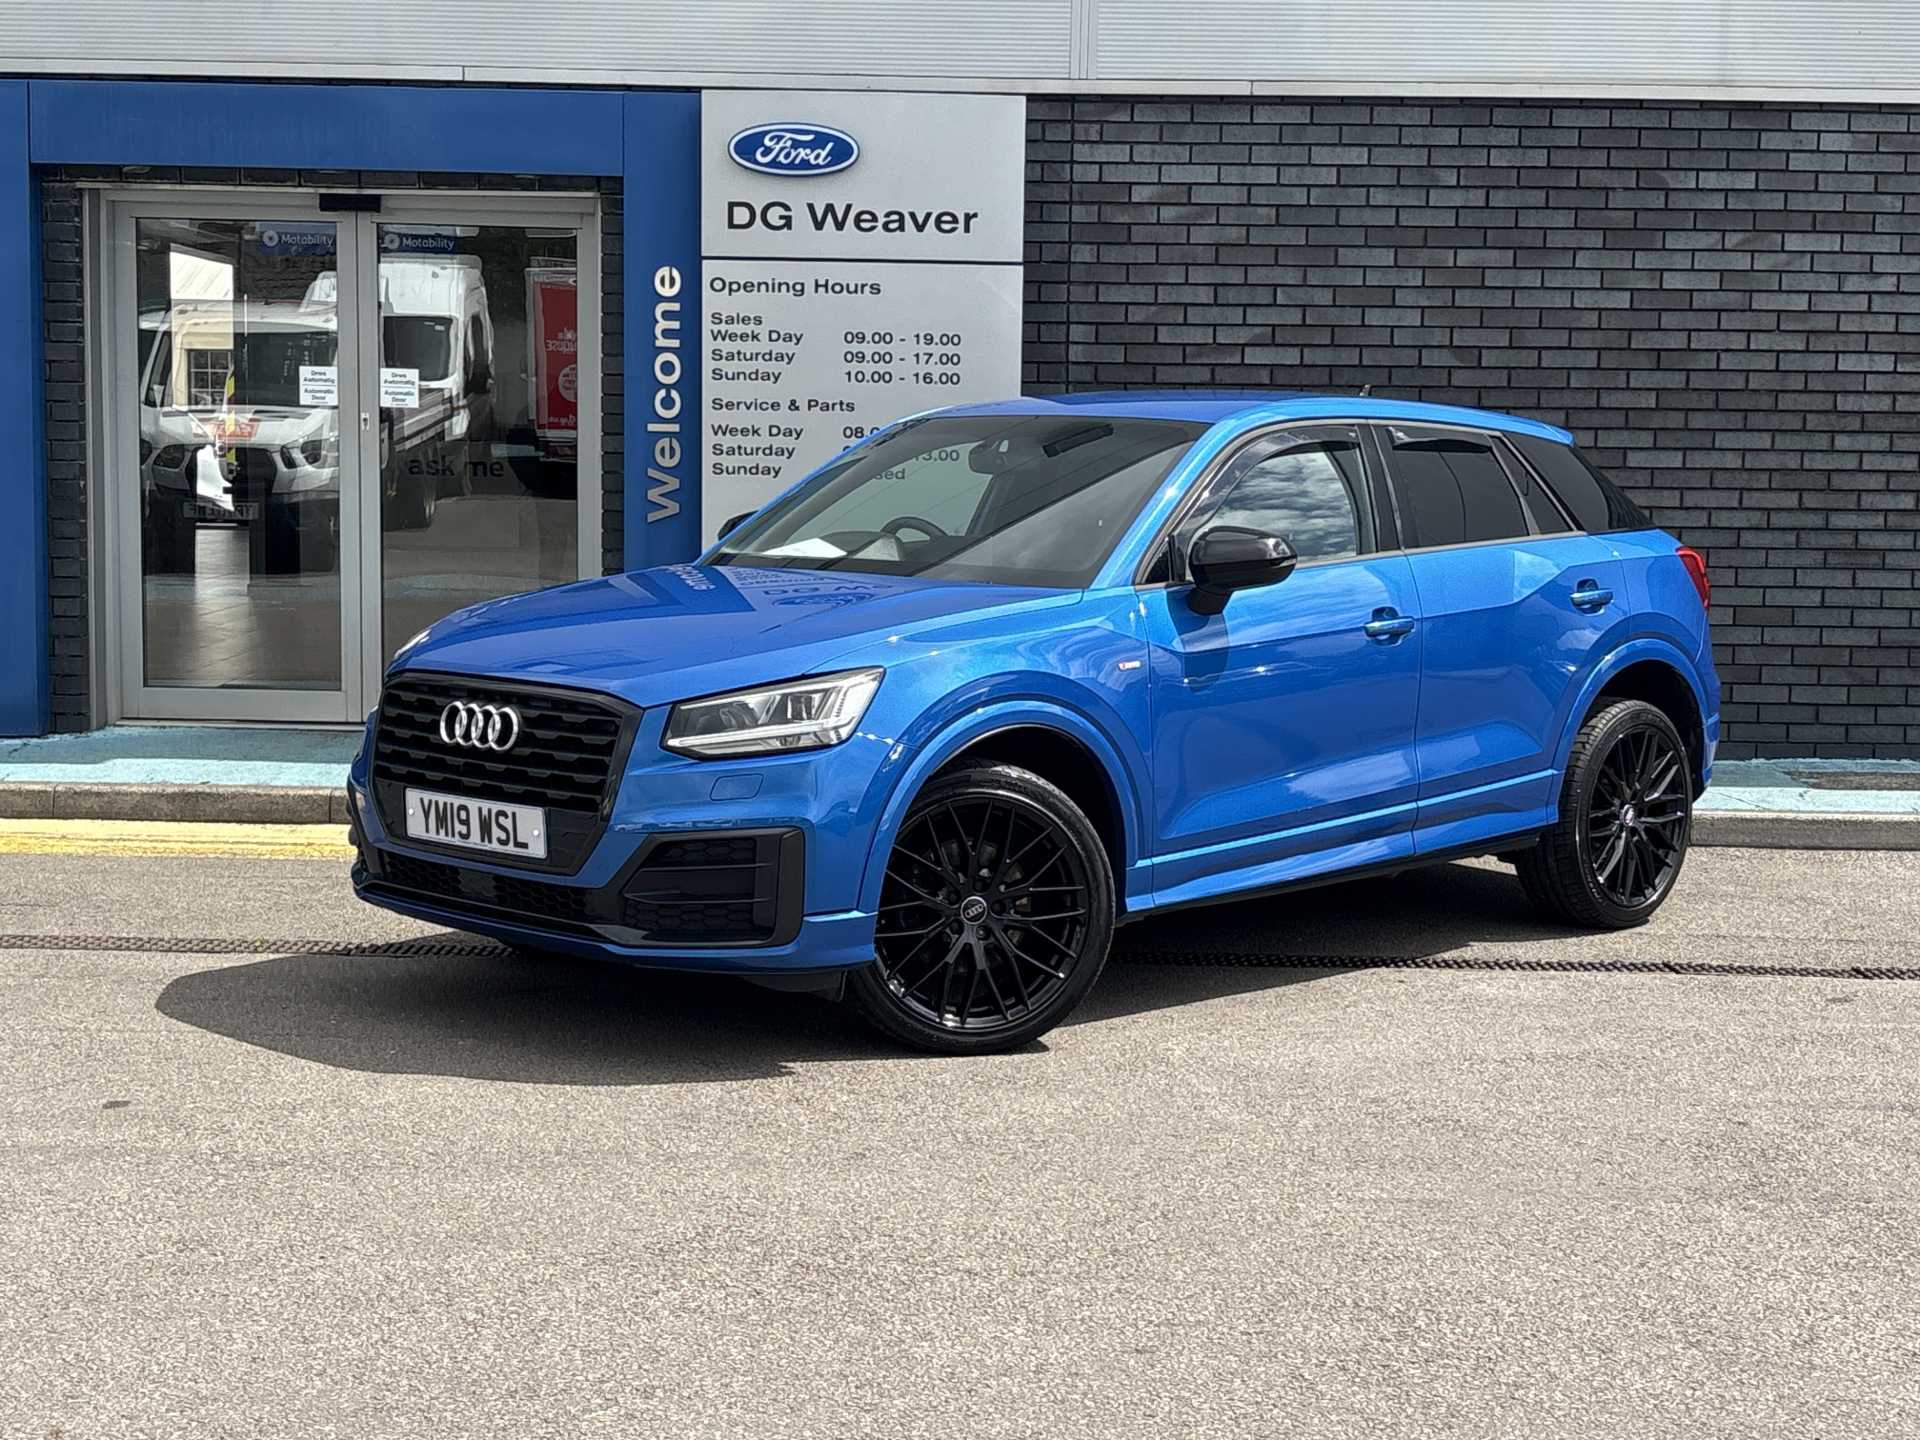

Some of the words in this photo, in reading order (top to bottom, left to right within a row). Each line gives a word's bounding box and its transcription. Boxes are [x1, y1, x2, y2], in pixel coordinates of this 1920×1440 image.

[755, 130, 834, 165] Ford
[727, 200, 793, 232] DG
[806, 202, 979, 234] Weaver
[281, 233, 334, 248] Motability
[402, 237, 455, 252] Motability
[709, 276, 806, 297] Opening
[814, 278, 882, 296] Hours
[710, 311, 763, 326] Sales
[710, 328, 761, 343] Week
[768, 329, 804, 346] Day
[843, 331, 894, 345] 09.00
[913, 332, 962, 347] 19.00
[711, 348, 796, 366] Saturday
[843, 350, 894, 365] 09.00
[913, 352, 961, 367] 17.00
[711, 367, 782, 385] Sunday
[845, 370, 893, 384] 10.00
[912, 371, 961, 386] 16.00
[646, 265, 682, 524] Welcome
[711, 397, 781, 412] Service
[787, 398, 801, 412] &
[807, 398, 856, 413] Parts
[710, 423, 762, 438] Week
[768, 424, 804, 441] Day
[711, 443, 796, 460] Saturday
[408, 454, 456, 477] ask
[711, 462, 782, 479] Sunday
[420, 797, 471, 840] YM19
[478, 806, 529, 850] WSL
